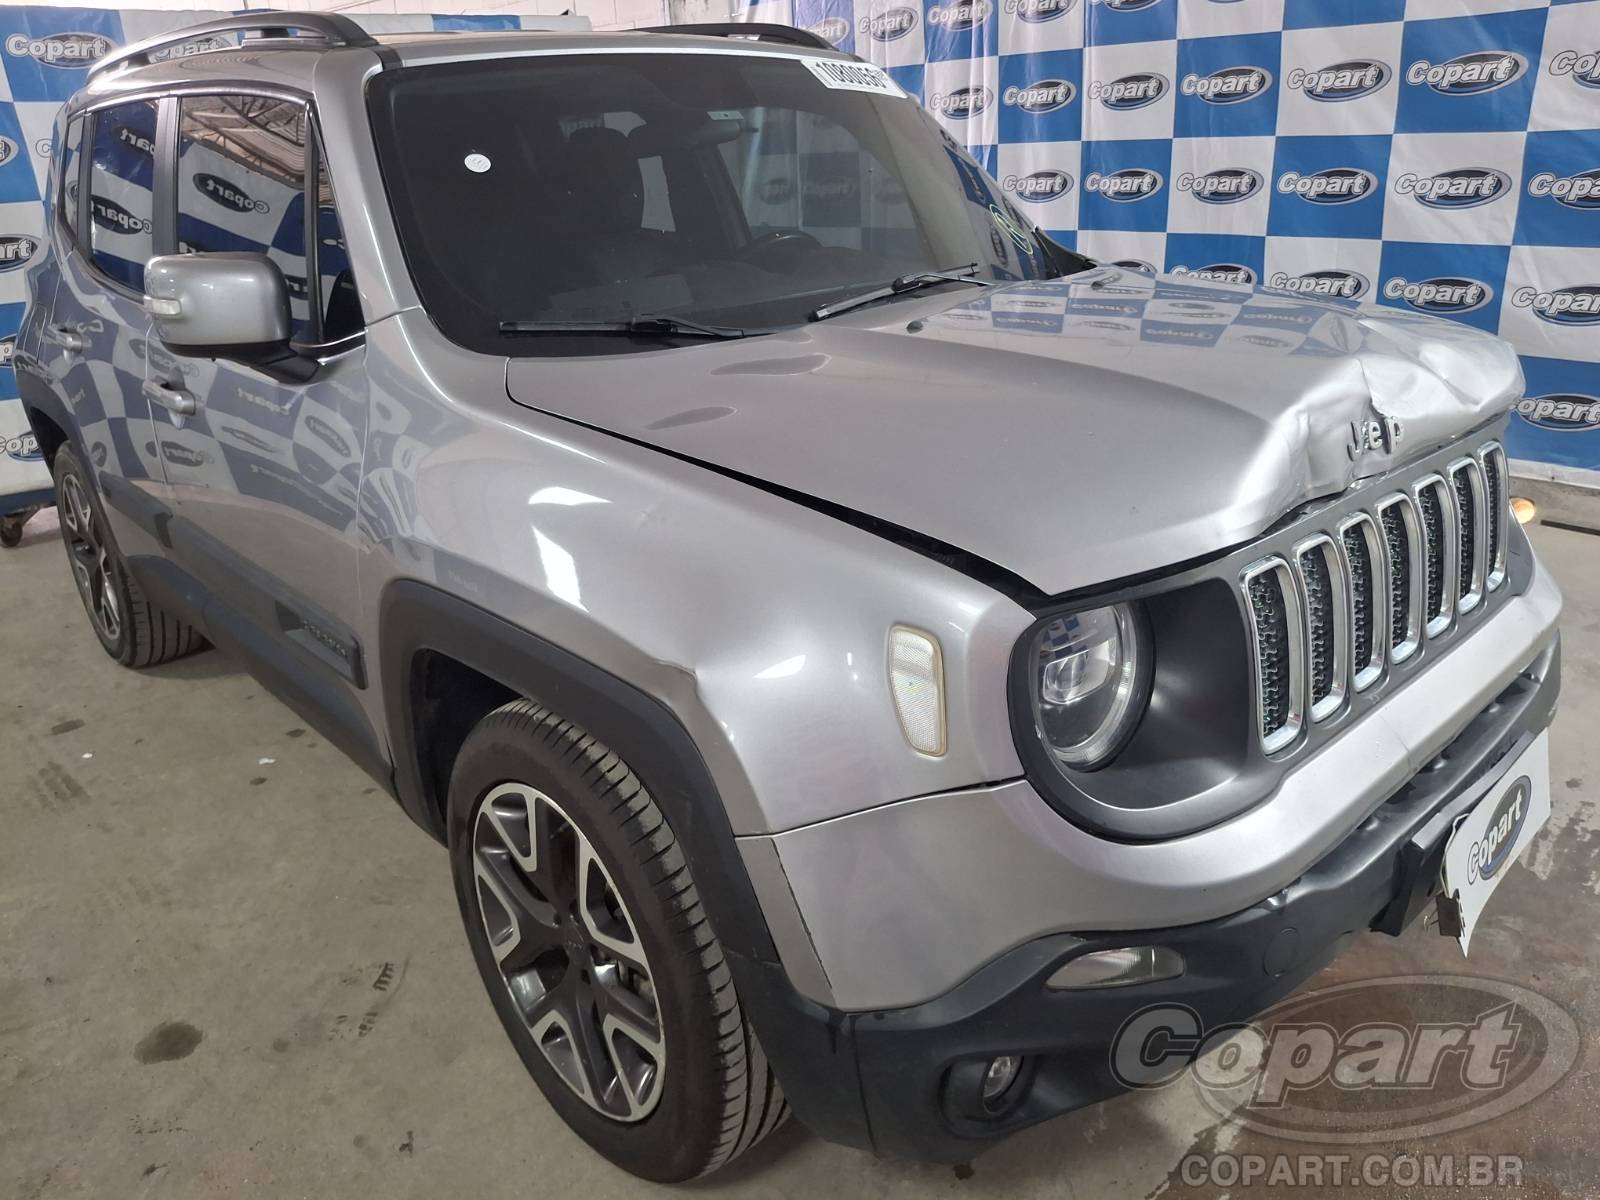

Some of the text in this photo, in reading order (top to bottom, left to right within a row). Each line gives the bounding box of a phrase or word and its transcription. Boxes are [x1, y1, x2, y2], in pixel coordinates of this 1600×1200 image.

[859, 11, 911, 35] Copart
[928, 0, 986, 26] Copart
[5, 33, 106, 63] Copart
[1180, 70, 1261, 98] Copart
[1287, 63, 1379, 94] Copart
[1406, 55, 1514, 89] Copart
[929, 90, 987, 113] Copart
[1003, 83, 1070, 108] Copart
[1088, 78, 1162, 103] Copart
[1003, 174, 1066, 196] Copart
[1085, 172, 1157, 196] Copart
[1175, 172, 1254, 196] Copart
[1277, 172, 1369, 198] Copart
[1395, 173, 1501, 200] Copart
[1270, 272, 1361, 297] Copart
[1383, 277, 1480, 305] Copart
[1509, 397, 1600, 424] opart
[1467, 788, 1522, 885] Copart
